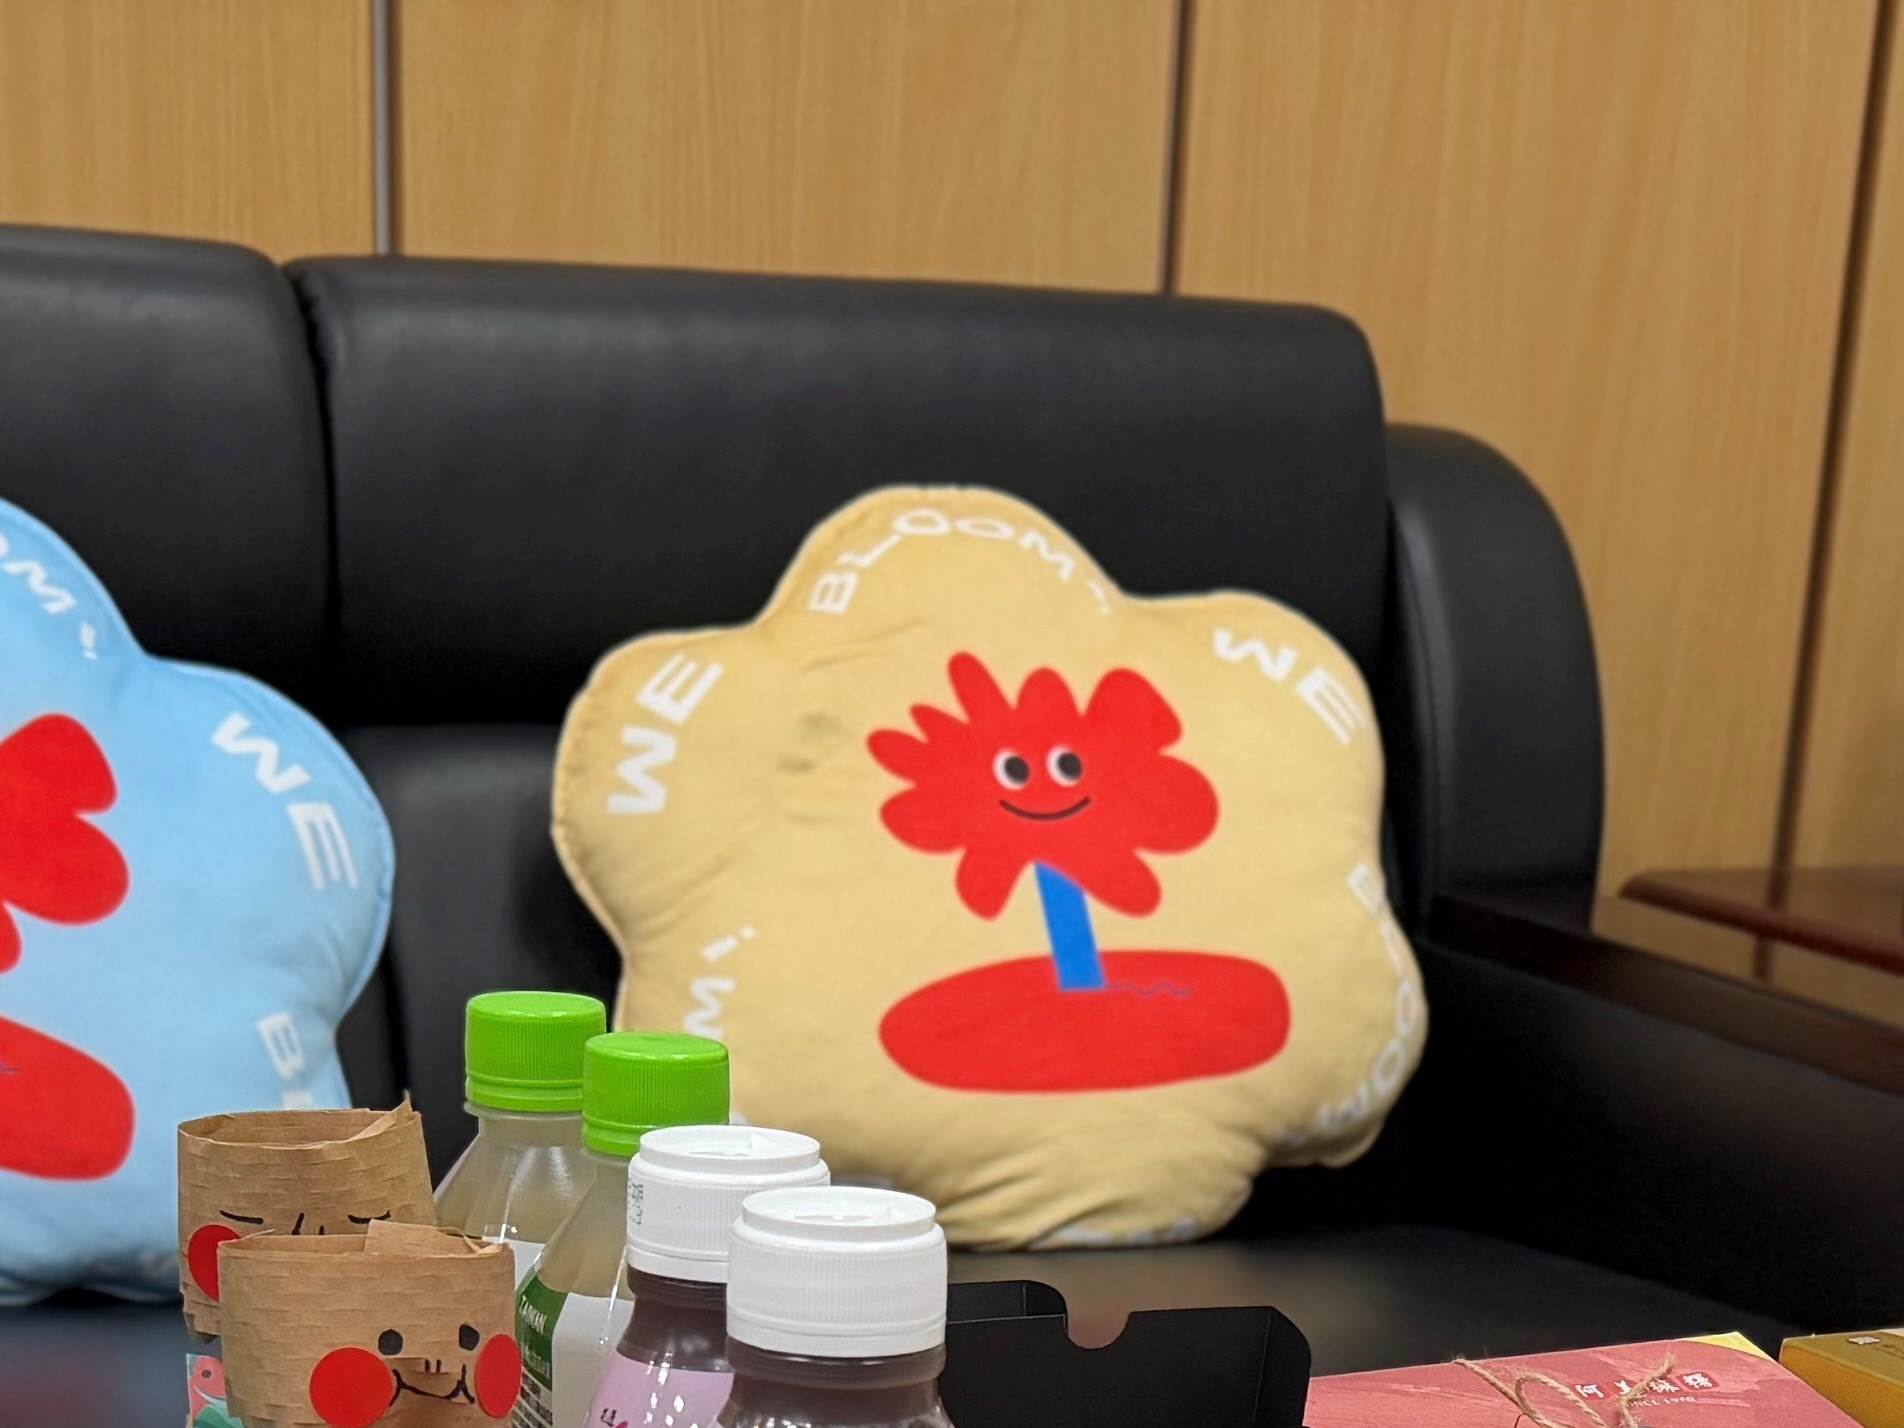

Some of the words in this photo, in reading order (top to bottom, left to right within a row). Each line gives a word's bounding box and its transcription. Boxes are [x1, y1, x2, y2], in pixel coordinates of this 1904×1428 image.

[605, 651, 724, 816] WE
[1211, 626, 1367, 745] WE
[212, 712, 360, 892] WE
